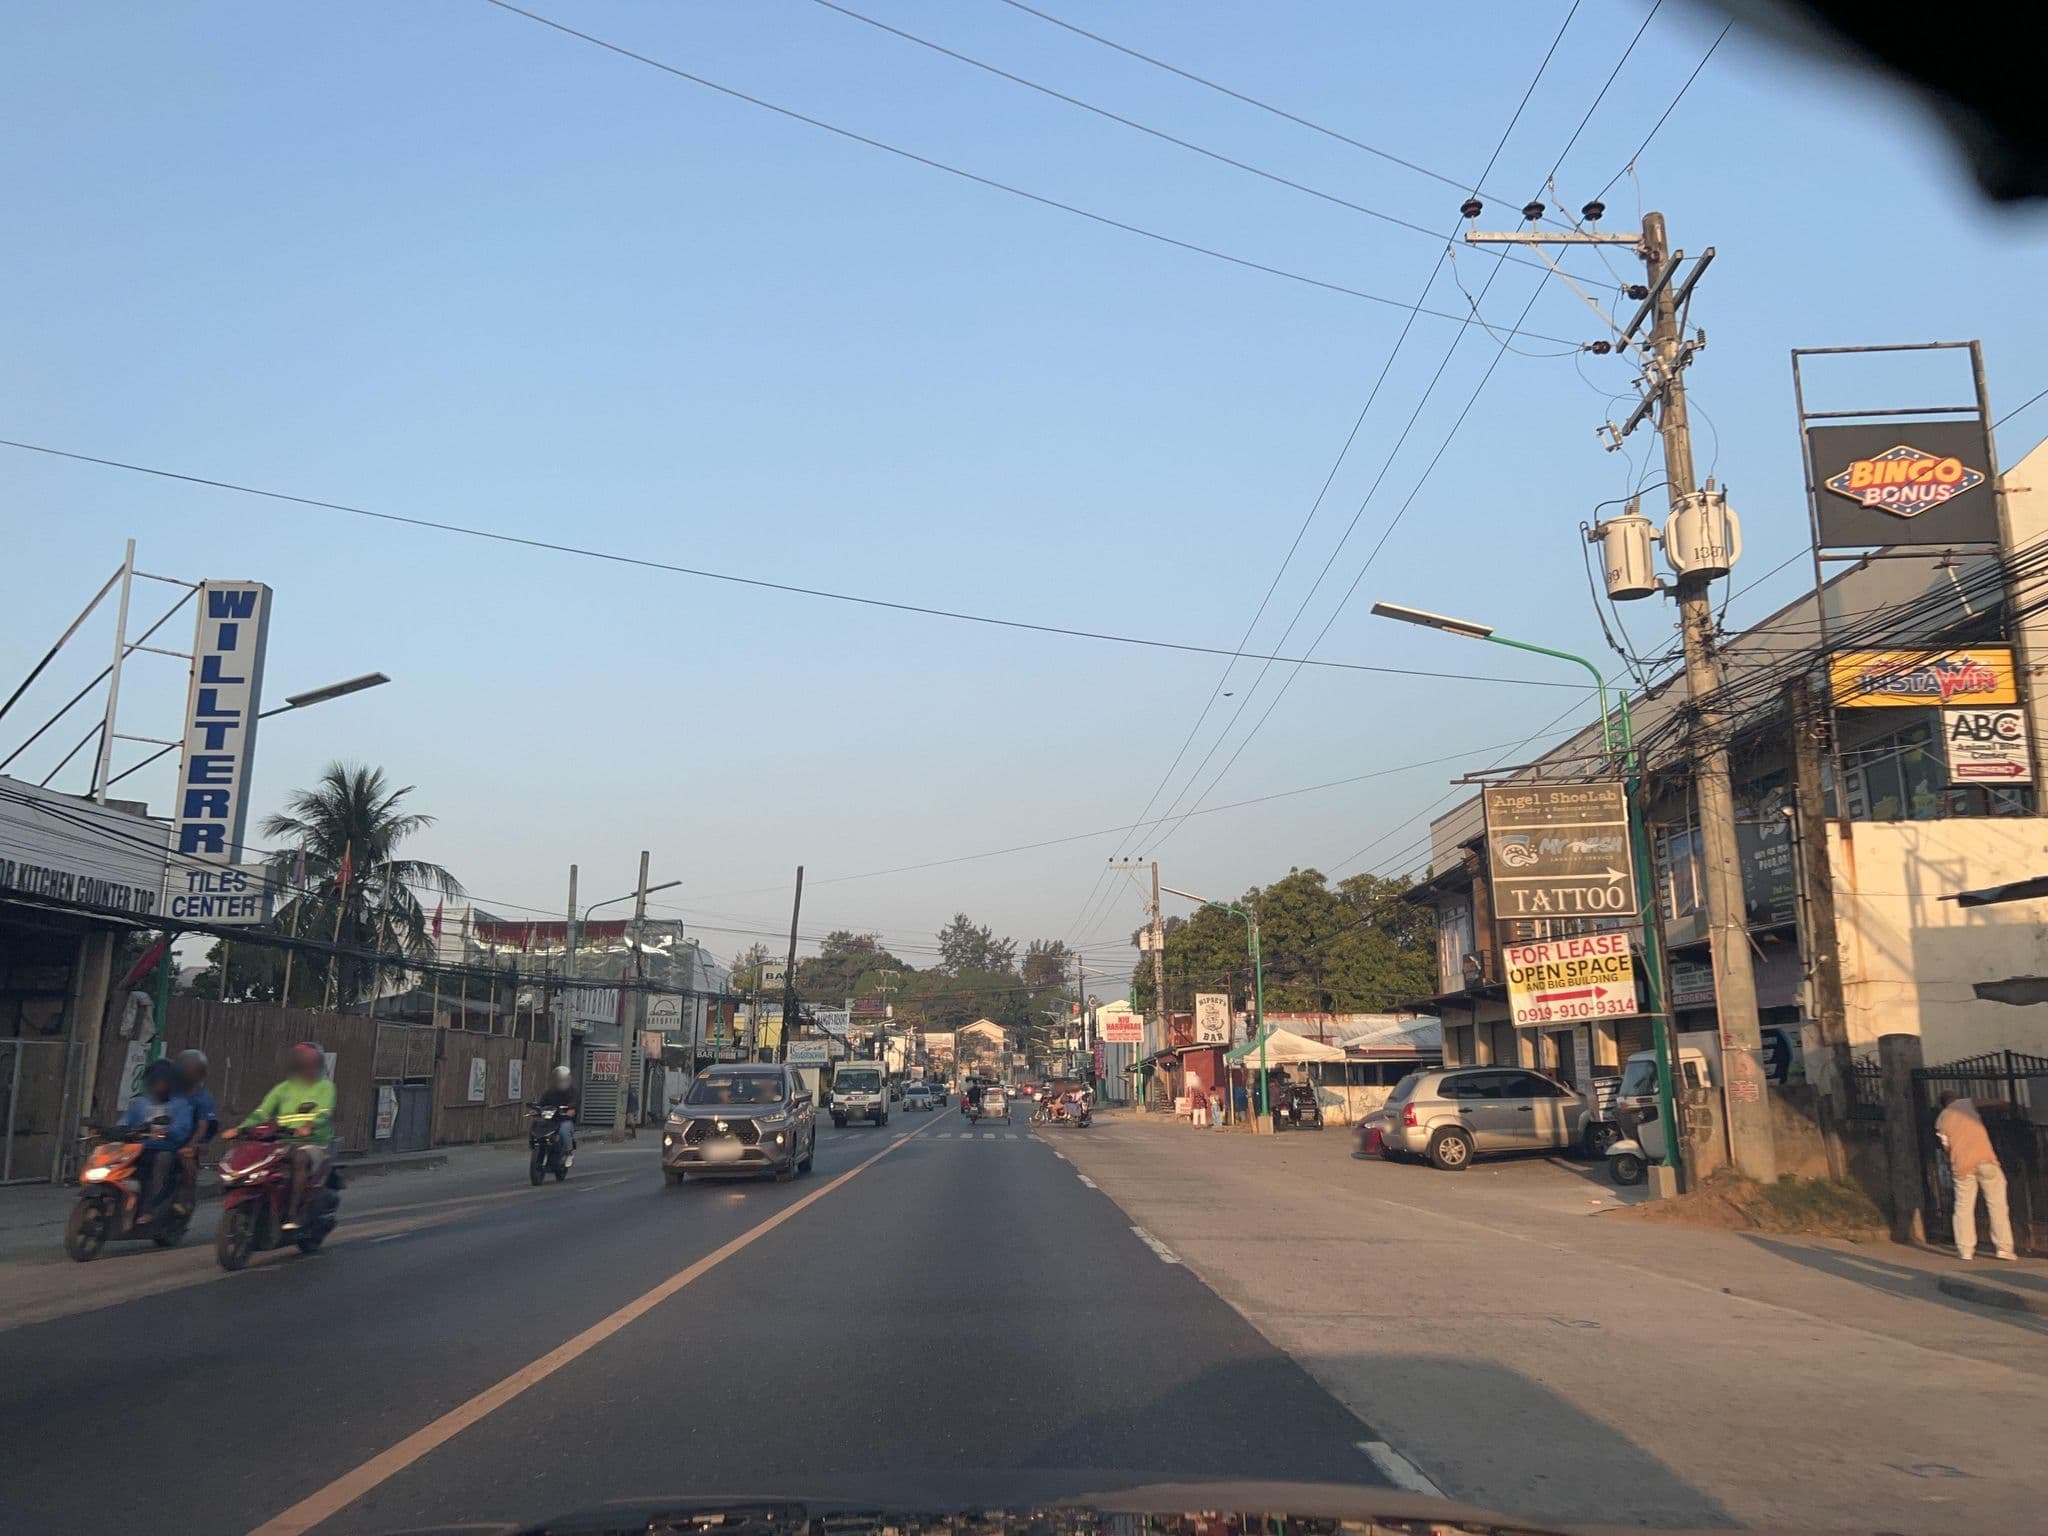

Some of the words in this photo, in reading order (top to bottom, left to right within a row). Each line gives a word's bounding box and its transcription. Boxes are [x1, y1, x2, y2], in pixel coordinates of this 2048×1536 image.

[1851, 458, 1963, 488] BINGO
[1864, 484, 1952, 506] BONUS
[179, 590, 258, 854] WILLTERR
[1951, 712, 2022, 742] ABC
[17, 862, 75, 901] KITCHEN
[77, 875, 132, 910] COUNTER
[134, 888, 155, 914] TOP
[186, 871, 249, 894] TILES
[171, 895, 256, 919] CENTER
[1511, 886, 1625, 913] TATTOO
[1510, 945, 1551, 966] FOR
[1556, 935, 1624, 960] LEASE
[1509, 964, 1561, 984] OPEN
[1566, 955, 1630, 977] SPACE
[1526, 982, 1546, 992] AND
[1548, 980, 1566, 989] BIG
[1568, 974, 1619, 987] BUILDING
[1203, 1032, 1224, 1042] BAR
[696, 1050, 713, 1059] BAR
[596, 1062, 622, 1073] INSID
